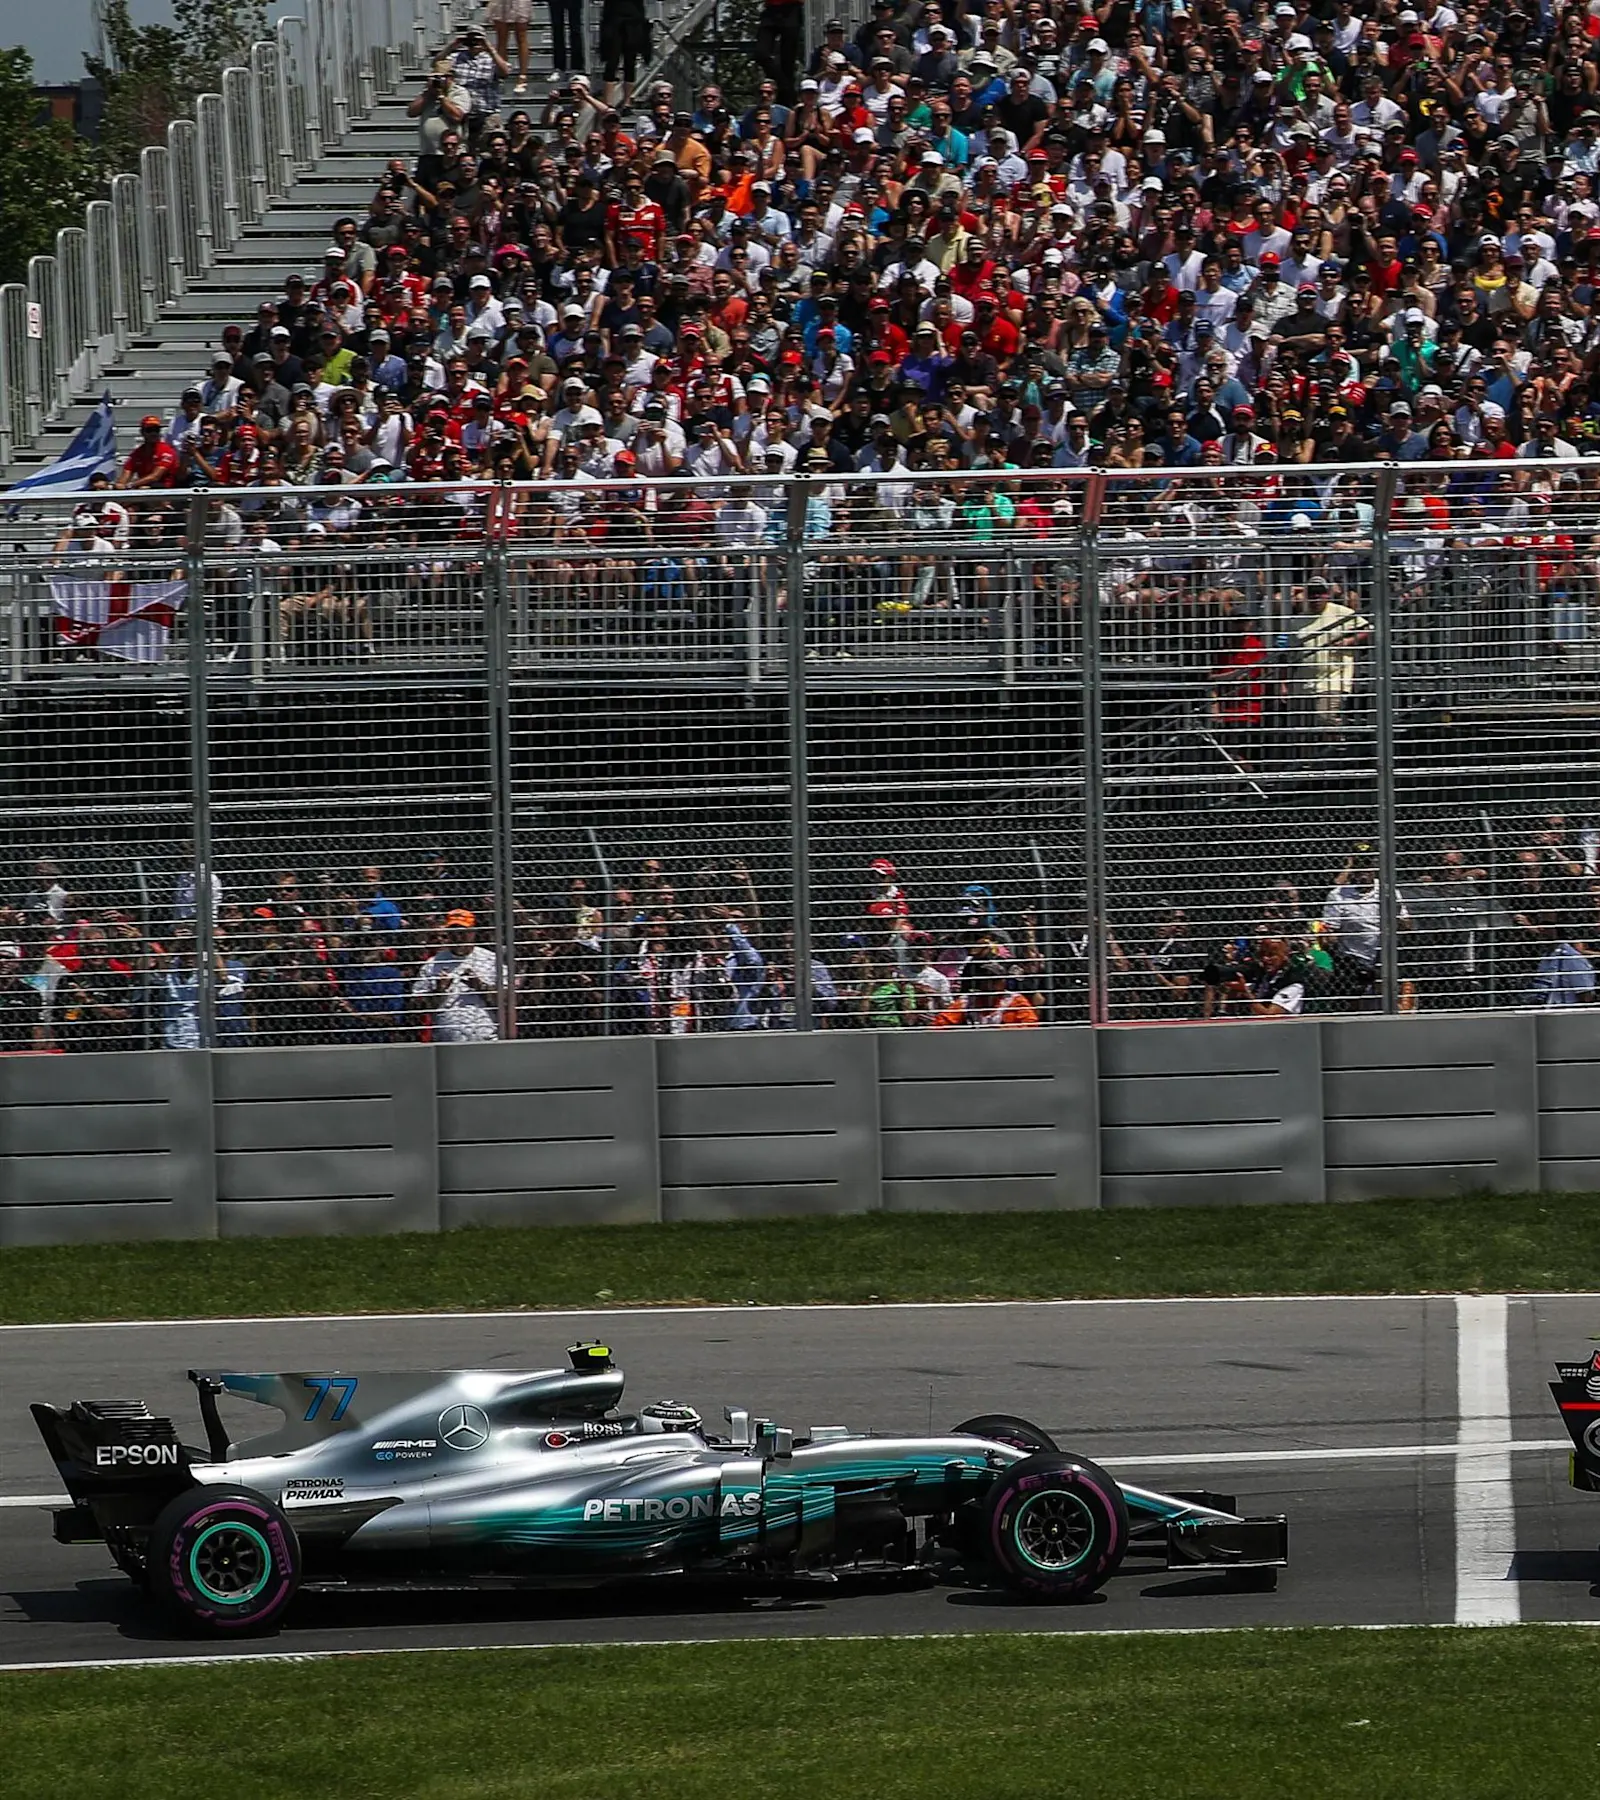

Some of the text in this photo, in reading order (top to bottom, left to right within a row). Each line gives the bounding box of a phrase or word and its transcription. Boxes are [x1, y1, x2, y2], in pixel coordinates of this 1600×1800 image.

[304, 1377, 358, 1421] 77
[583, 1422, 623, 1433] BOSS
[393, 1440, 437, 1448] AMG
[96, 1445, 178, 1465] EPSON
[287, 1478, 344, 1488] PETRONAS
[286, 1489, 344, 1500] PRIMAX
[583, 1492, 762, 1522] PETRONAS
